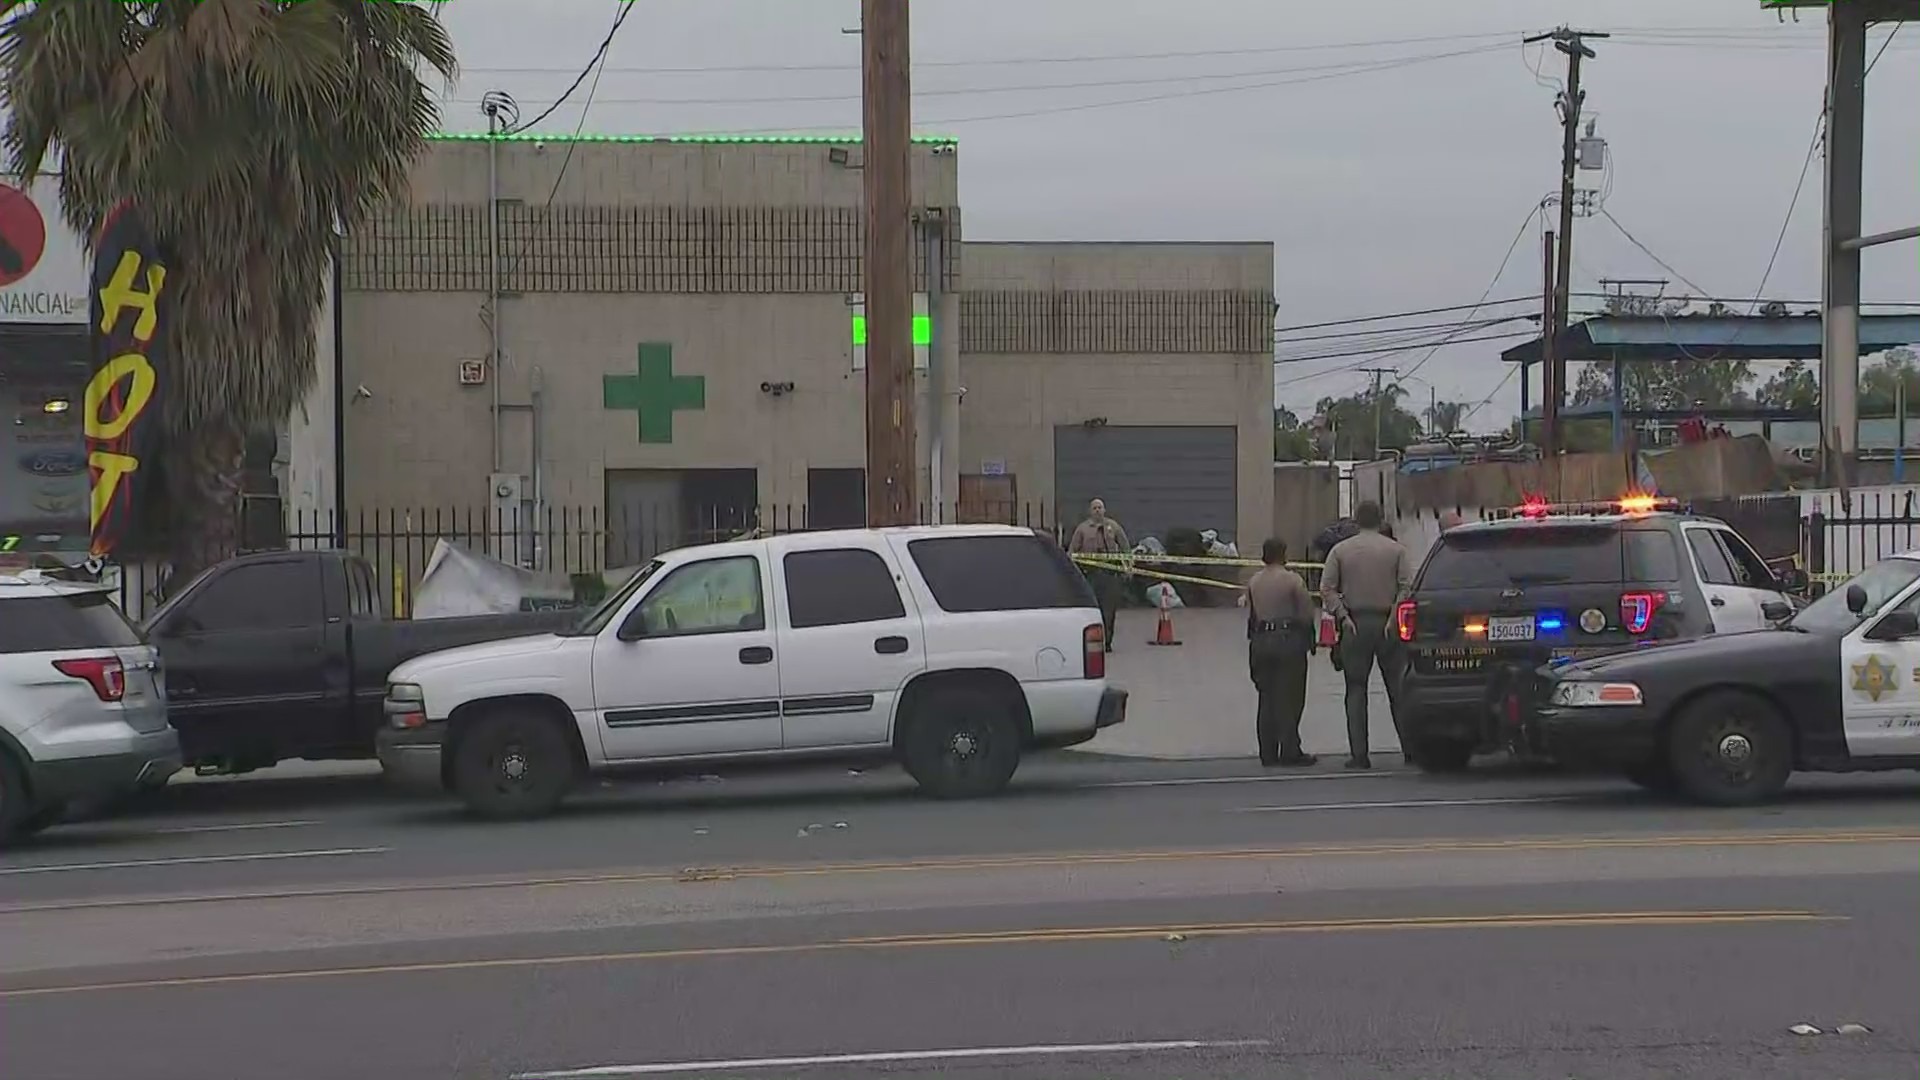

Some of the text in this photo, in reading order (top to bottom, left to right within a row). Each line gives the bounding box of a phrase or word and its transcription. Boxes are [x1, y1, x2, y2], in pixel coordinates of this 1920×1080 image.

[0, 291, 73, 314] NANCIAL
[83, 250, 167, 532] HOT
[1491, 624, 1532, 638] 1504037
[1435, 659, 1481, 670] SHERIFF
